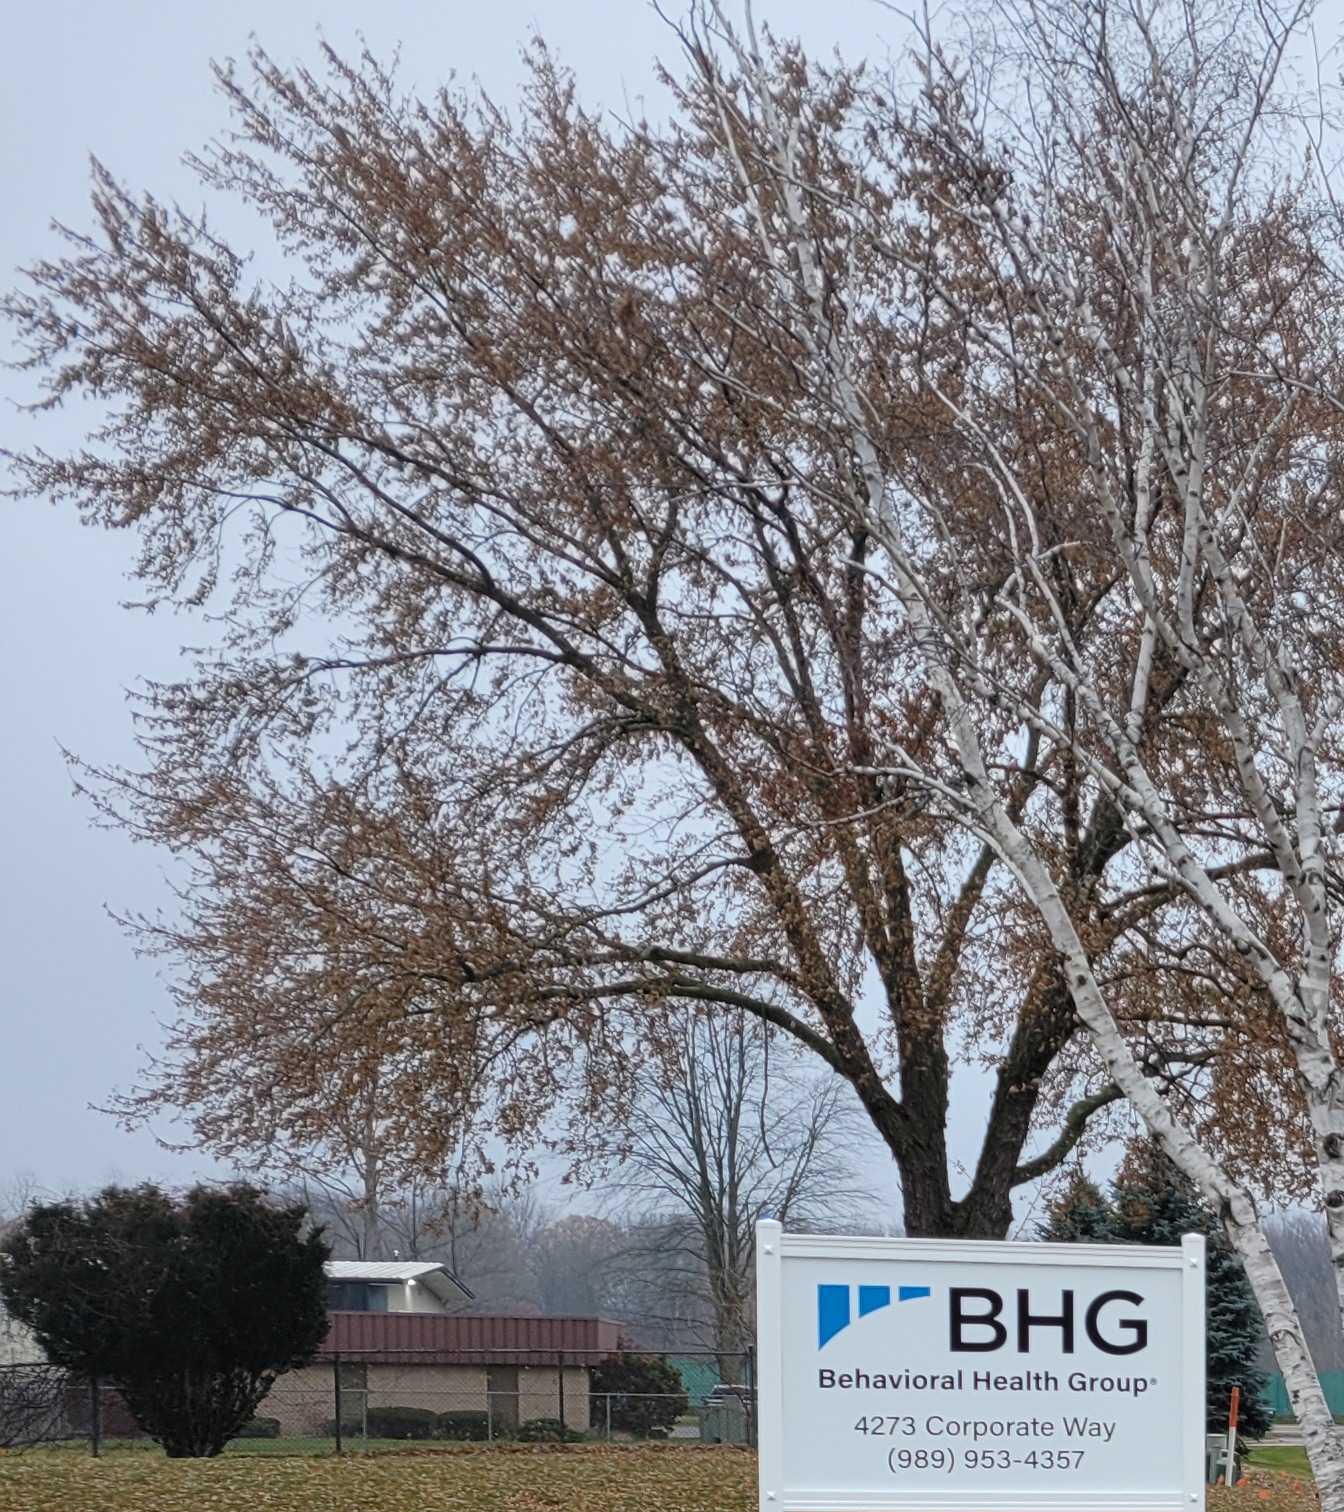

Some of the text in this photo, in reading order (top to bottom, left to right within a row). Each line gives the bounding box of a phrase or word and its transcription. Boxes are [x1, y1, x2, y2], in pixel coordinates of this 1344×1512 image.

[949, 1286, 1148, 1356] BHG
[818, 1368, 963, 1391] Behavioral
[973, 1370, 1059, 1392] Health
[853, 1415, 1117, 1443] 4273 Corporate Way
[888, 1447, 1085, 1474] (989) 953-4357
